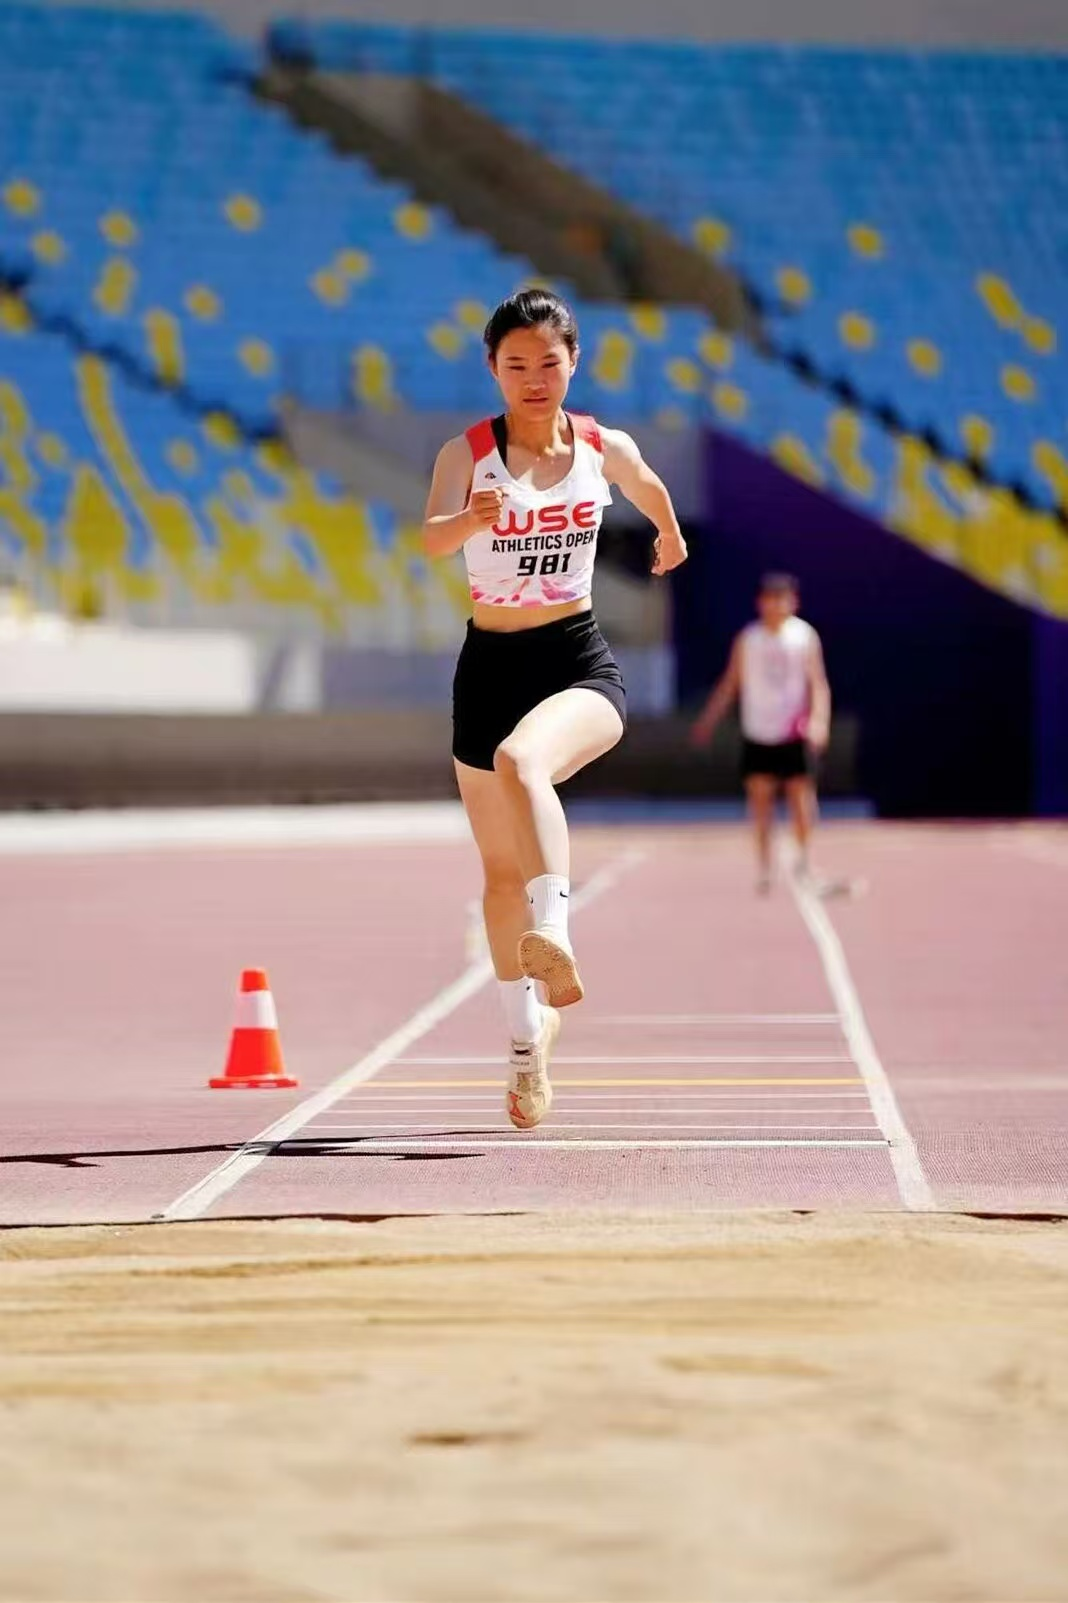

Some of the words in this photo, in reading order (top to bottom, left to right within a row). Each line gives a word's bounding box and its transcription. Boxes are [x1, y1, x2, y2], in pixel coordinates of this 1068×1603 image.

[491, 501, 597, 536] WSE
[492, 534, 562, 552] ATHLETICS
[566, 530, 596, 547] OPEN
[517, 553, 571, 576] 981
